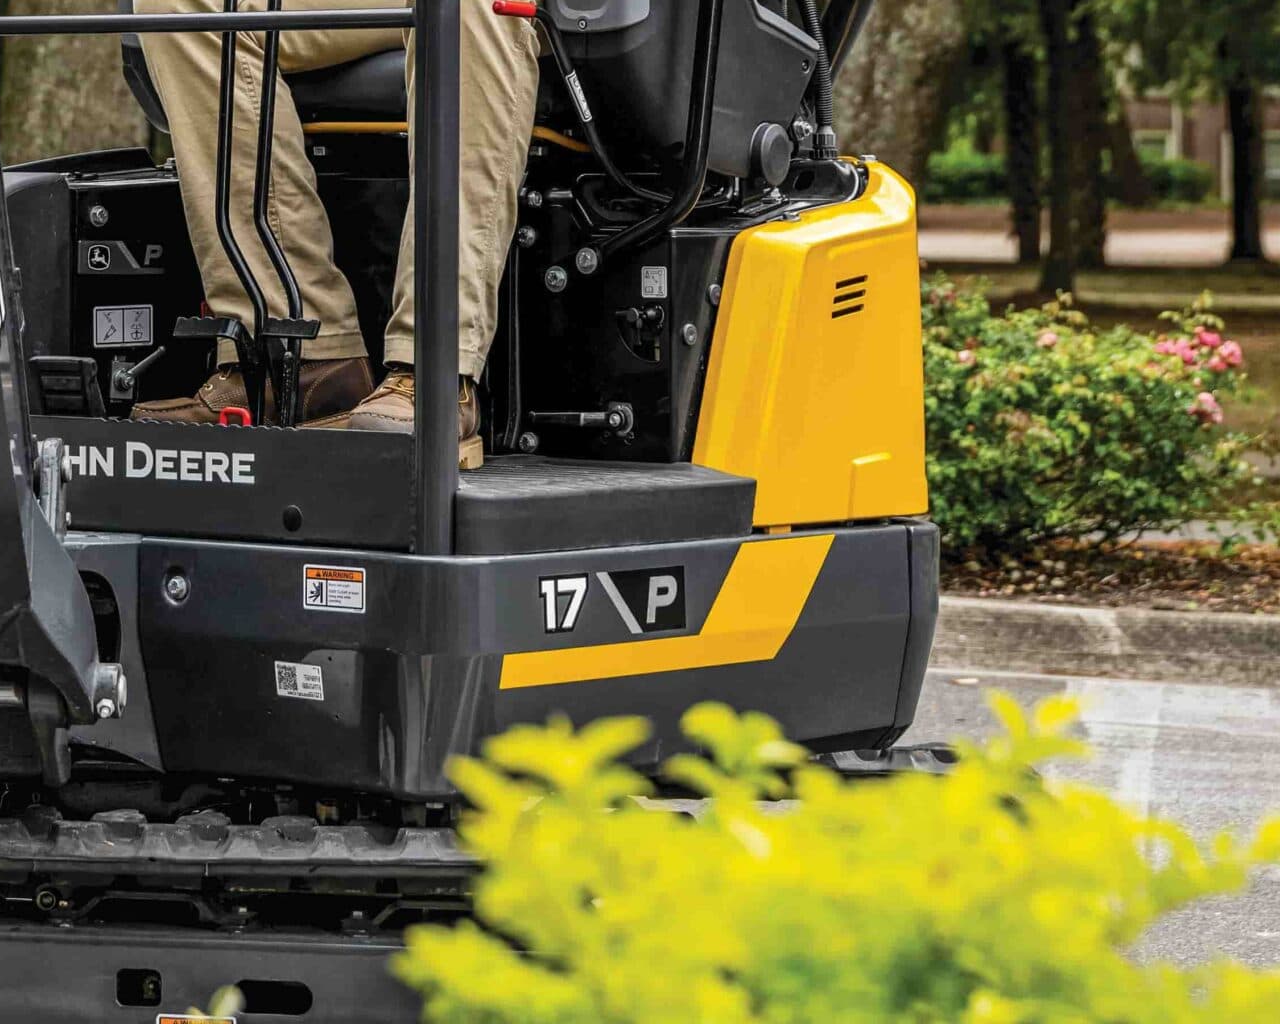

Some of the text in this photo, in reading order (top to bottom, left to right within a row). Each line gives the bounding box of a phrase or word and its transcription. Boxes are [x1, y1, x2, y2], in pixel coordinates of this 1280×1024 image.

[63, 441, 255, 484] HN DEERE
[540, 576, 588, 631] 17
